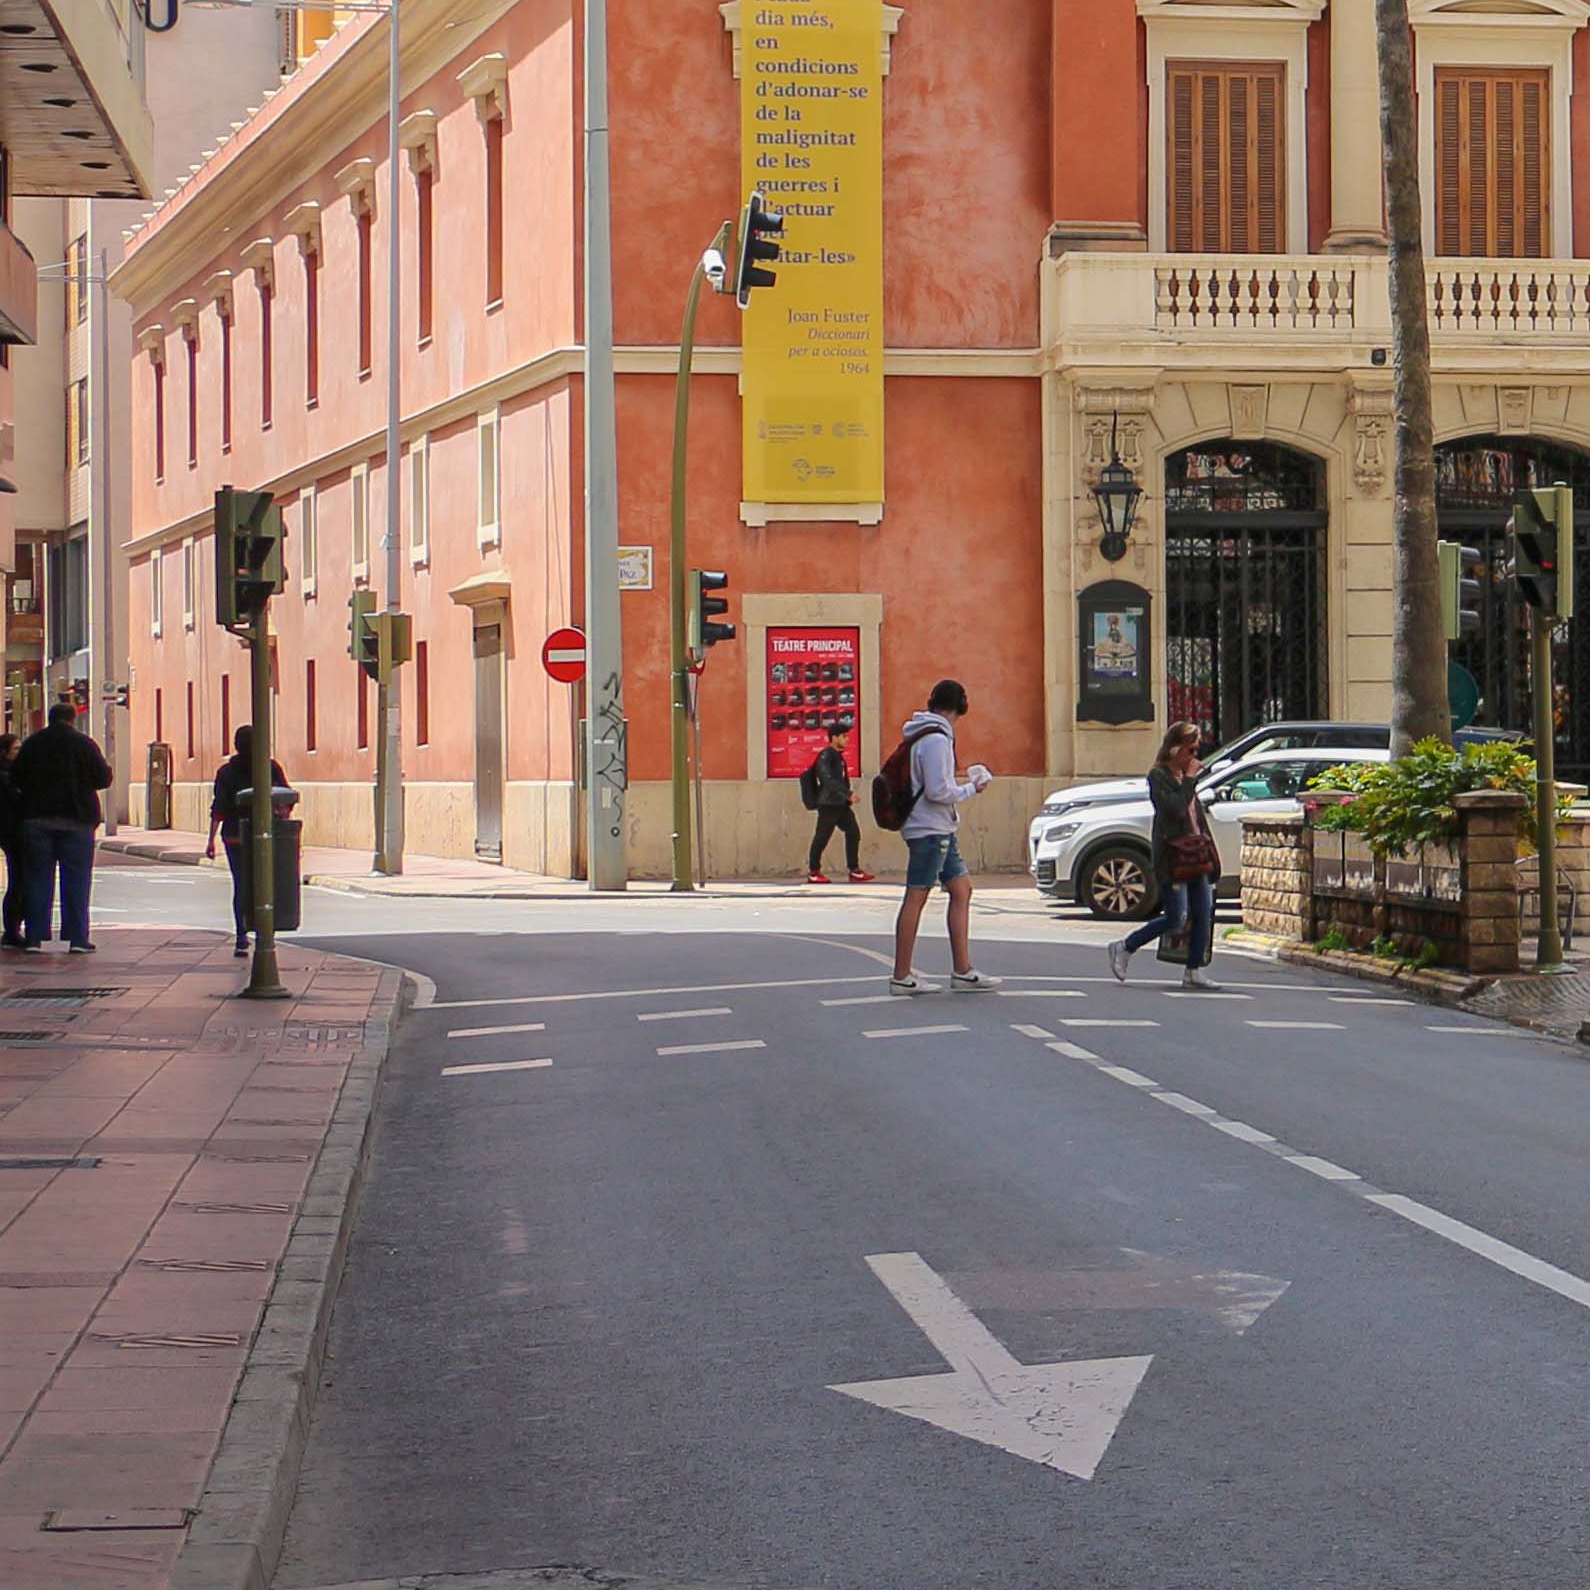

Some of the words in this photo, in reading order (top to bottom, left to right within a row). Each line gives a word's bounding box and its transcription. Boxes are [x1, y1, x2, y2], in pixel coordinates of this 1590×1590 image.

[755, 10, 785, 26] dia
[791, 10, 834, 29] més,
[755, 37, 779, 49] en
[755, 58, 859, 75] condicions
[755, 81, 869, 98] d'adonar-se
[755, 105, 778, 121] de
[784, 105, 801, 121] la
[756, 129, 856, 149] malignitat
[756, 152, 779, 168] de
[784, 153, 811, 168] les
[756, 179, 828, 195] guerres
[834, 177, 840, 193] i
[787, 309, 819, 324] Joan
[823, 309, 871, 324] Fuster
[808, 328, 871, 340] Diccionari
[788, 345, 807, 359] per
[811, 347, 819, 356] a
[839, 362, 870, 375] 1964
[772, 639, 806, 653] TEATRE
[807, 639, 854, 653] PRINCIPAL
